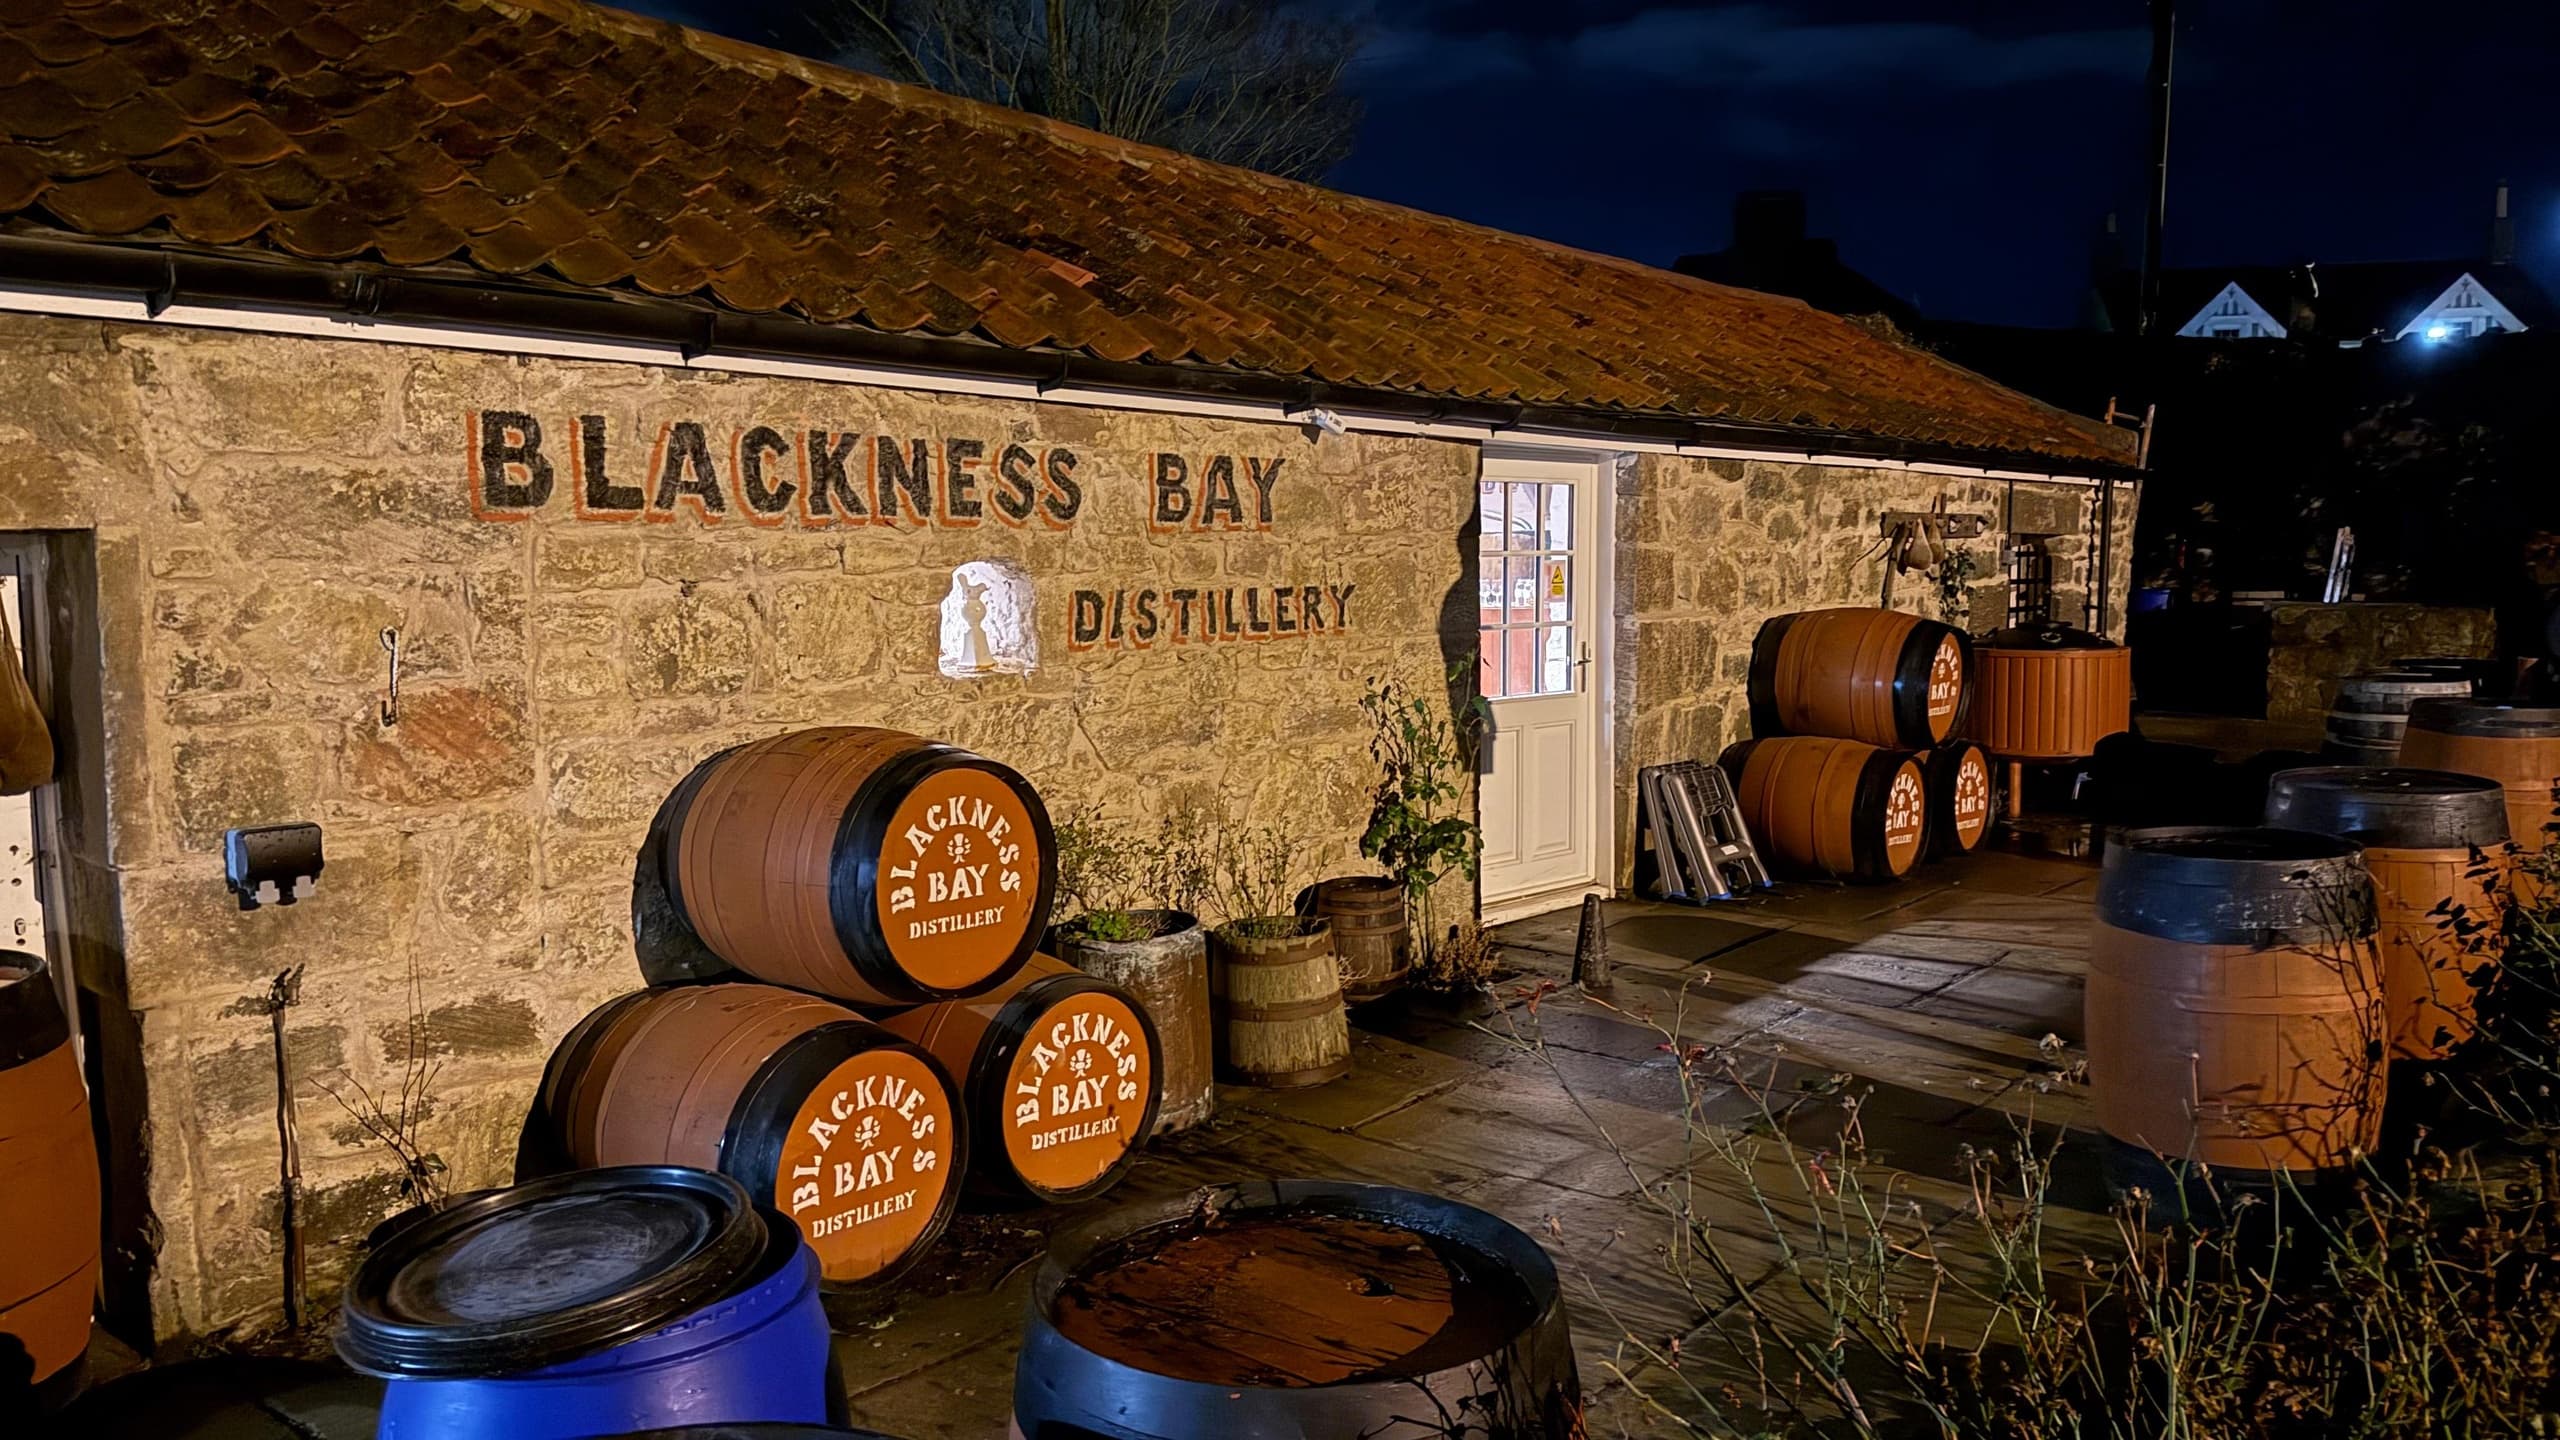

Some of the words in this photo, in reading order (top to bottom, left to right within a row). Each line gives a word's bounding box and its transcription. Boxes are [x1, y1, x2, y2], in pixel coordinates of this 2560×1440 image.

[468, 408, 1084, 531] BLACKNESS
[1149, 453, 1287, 533] BAY
[1067, 582, 1357, 652] DISTILLERY
[1931, 681, 1951, 701] BAY
[1961, 795, 1978, 814] BAY
[890, 796, 1021, 914] BLACKNESS
[928, 863, 990, 903] BAY
[909, 905, 1005, 940] DISTILLERY
[1016, 1012, 1138, 1128] BLACKNESS
[1051, 1075, 1111, 1116] BAY
[792, 1075, 937, 1216] BLACKNESS
[1031, 1114, 1121, 1151] DISTILLERY
[833, 1146, 902, 1197] BAY
[811, 1189, 918, 1239] DISTILLERY
